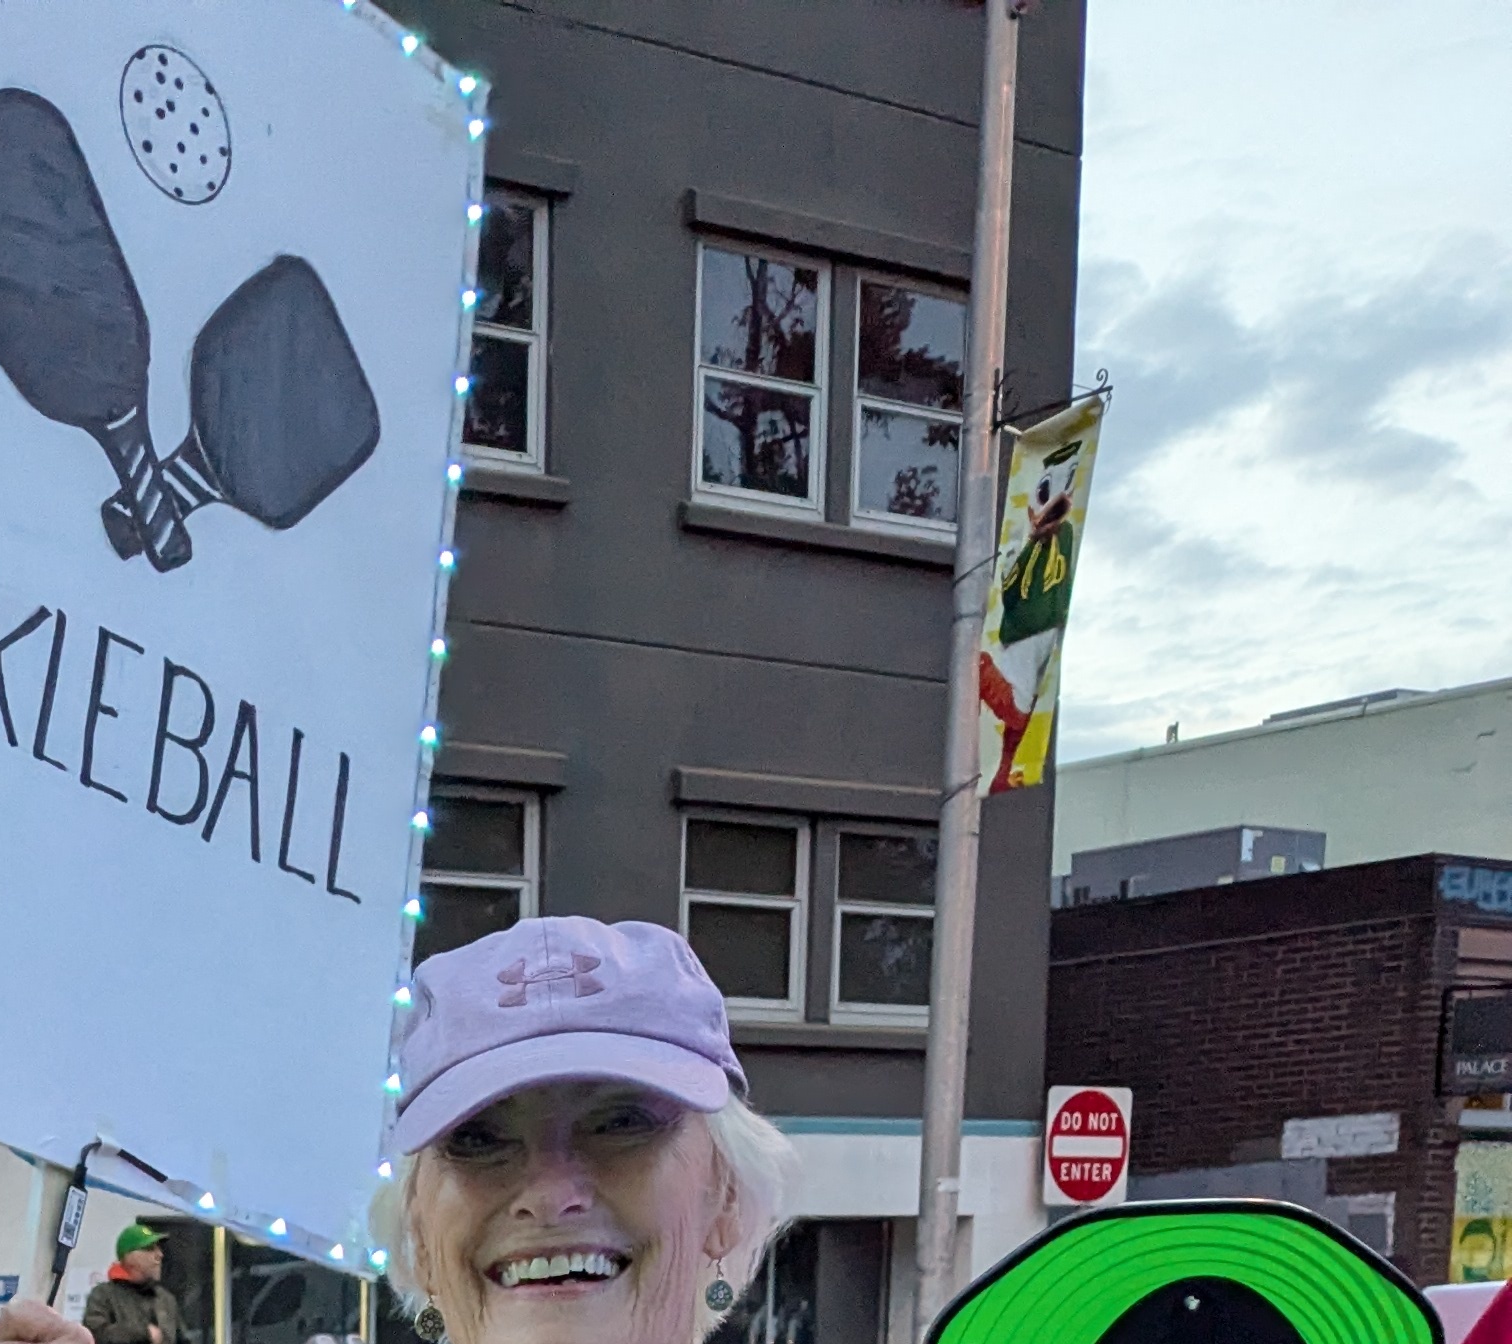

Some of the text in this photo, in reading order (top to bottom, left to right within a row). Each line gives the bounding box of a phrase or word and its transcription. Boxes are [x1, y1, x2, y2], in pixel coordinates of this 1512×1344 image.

[1456, 1059, 1509, 1076] PALACE
[1060, 1111, 1118, 1131] DO NOT
[1060, 1162, 1112, 1182] ENTER
